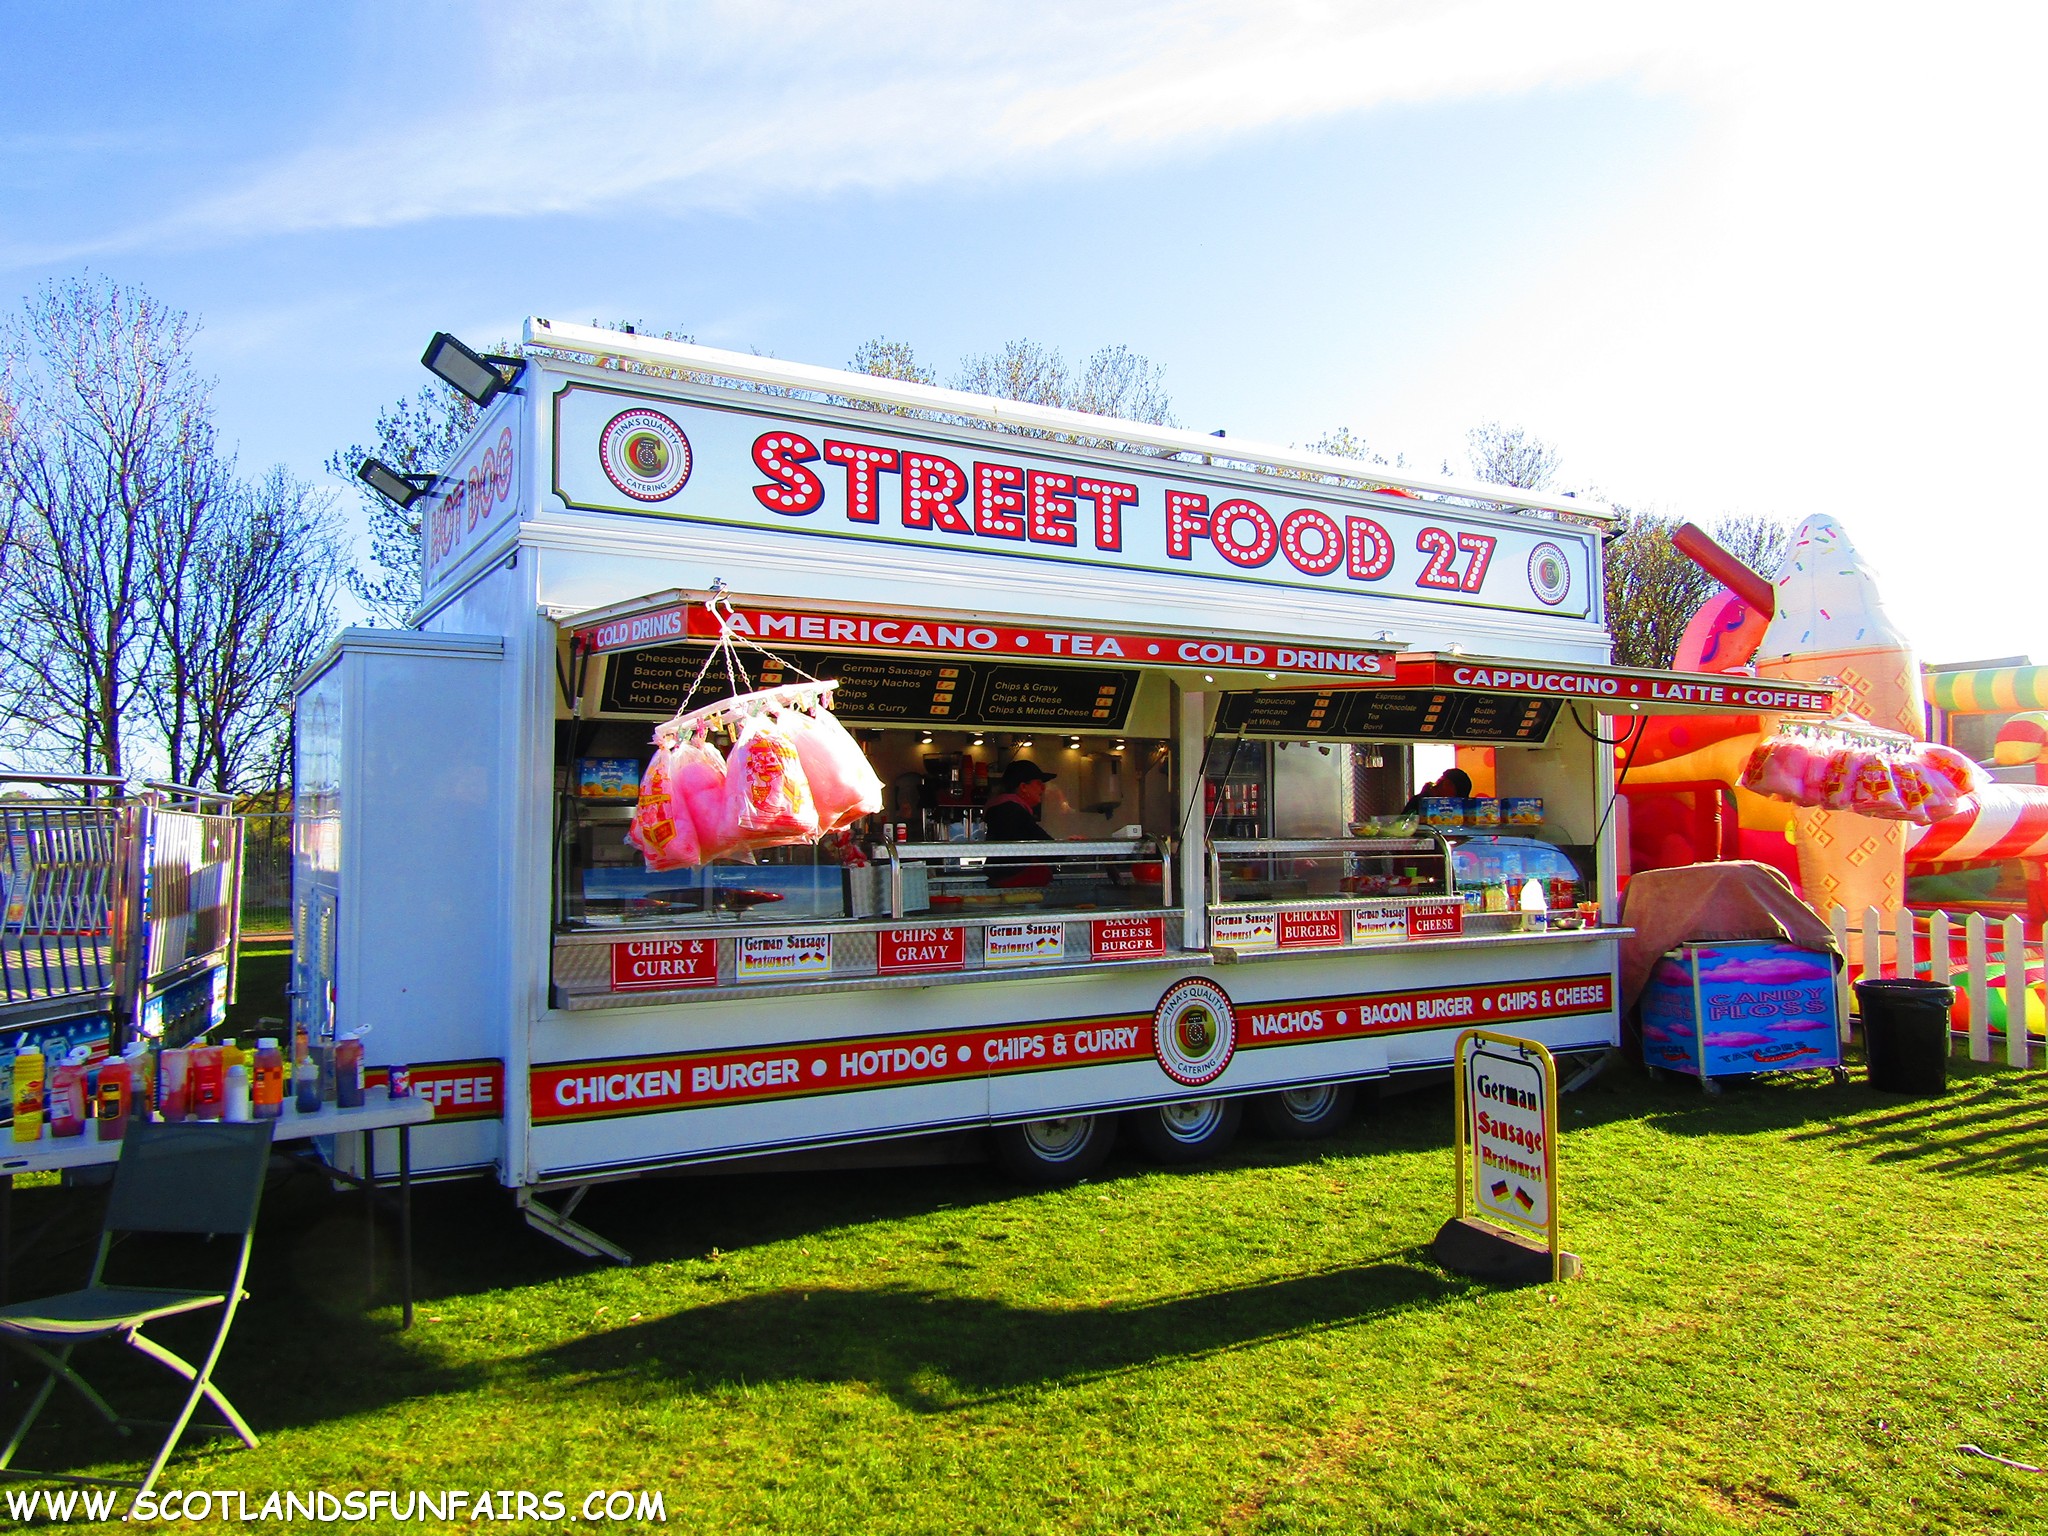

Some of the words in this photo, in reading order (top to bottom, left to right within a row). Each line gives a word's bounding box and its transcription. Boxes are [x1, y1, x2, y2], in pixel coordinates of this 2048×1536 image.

[614, 418, 641, 437] TINA'S
[642, 418, 679, 444] QUALITY
[626, 477, 667, 492] CATERING
[430, 479, 465, 569] HOT
[467, 426, 514, 534] DOG
[751, 430, 1140, 553] STREET
[1165, 489, 1396, 582] FOOD
[1415, 526, 1498, 595] 27
[596, 622, 629, 647] COLD
[632, 611, 682, 641] DRINKS
[719, 612, 998, 650] AMERICANO
[1045, 633, 1125, 658] TEA
[1177, 642, 1266, 665] COLD
[1277, 649, 1382, 673] DRINKS
[634, 667, 673, 677] Bacon
[842, 663, 885, 674] German
[887, 665, 933, 677] Sausage
[631, 680, 680, 691] Chicken
[682, 683, 723, 694] Brger
[839, 676, 880, 688] Cheesy
[881, 678, 921, 689] Nachos
[994, 681, 1021, 692] Chips
[1022, 683, 1030, 691] &
[1032, 683, 1059, 694] Gravy
[1453, 667, 1618, 695] CAPPUCCINO
[1652, 683, 1724, 703] LATTE
[1744, 690, 1823, 710] COFFEE
[629, 694, 651, 703] Hot
[653, 695, 678, 706] Dog
[836, 688, 868, 699] Chips
[991, 693, 1018, 703] Chips
[1019, 695, 1027, 703] &
[1028, 695, 1063, 704] Cheese
[1374, 692, 1407, 701] Espresso
[834, 701, 865, 711] Chips
[867, 703, 875, 711] &
[878, 703, 908, 714] Curry
[1253, 698, 1296, 706] appuccino
[1370, 702, 1383, 710] Hot
[1384, 703, 1417, 712] Chocolate
[988, 705, 1015, 715] Chips
[1016, 706, 1024, 714] &
[1025, 706, 1055, 716] Melted
[1057, 708, 1090, 717] Cheese
[1250, 708, 1288, 716] mericano
[1474, 707, 1497, 715] Bottle
[1470, 717, 1493, 725] Water
[1465, 727, 1502, 735] Capri-Sun
[1284, 911, 1335, 923] CHICKEN
[1356, 908, 1380, 919] German
[1381, 907, 1405, 919] Sausage
[1415, 905, 1444, 916] CHIPS
[1446, 905, 1454, 915] &
[1105, 917, 1149, 927] BACON
[1214, 915, 1243, 926] German
[1245, 913, 1274, 925] Sausage
[1416, 919, 1454, 931] CHEESE
[891, 927, 937, 944] CHIPS
[942, 927, 954, 942] &
[988, 924, 1023, 938] German
[1025, 922, 1061, 936] Sausage
[1101, 927, 1153, 939] CHEESE
[1216, 930, 1252, 941] Bratwurst
[1284, 924, 1337, 938] BURGERS
[628, 940, 683, 957] CHIPS
[690, 939, 704, 954] &
[744, 936, 783, 951] German
[786, 934, 826, 950] Sausage
[989, 941, 1034, 954] Bratwurst
[895, 945, 949, 962] GRAVY
[632, 958, 698, 977] CURRY
[744, 953, 796, 969] Bratwurst
[1164, 989, 1188, 1016] TINA'S
[1189, 987, 1224, 1011] QUALITY
[1708, 987, 1827, 1007] CANDY
[1251, 1010, 1324, 1036] NACHOS
[1359, 1001, 1412, 1026] BACON
[1416, 996, 1474, 1020] BURGER
[1497, 989, 1539, 1012] CHIPS
[1541, 988, 1551, 1006] &
[1555, 985, 1604, 1006] CHEESE
[1708, 999, 1828, 1022] FLOSS
[1719, 1040, 1809, 1063] TAYLORS
[555, 1068, 682, 1106] CHICKEN
[692, 1059, 800, 1093] BURGER
[840, 1044, 948, 1078] HOTDOG
[983, 1035, 1046, 1062] CHIPS
[1052, 1033, 1068, 1056] &
[1074, 1027, 1139, 1054] CURRY
[1177, 1058, 1216, 1074] CATERING
[1477, 1074, 1537, 1112] German
[1477, 1110, 1543, 1155] Sausage
[1481, 1144, 1542, 1183] Bratwurst
